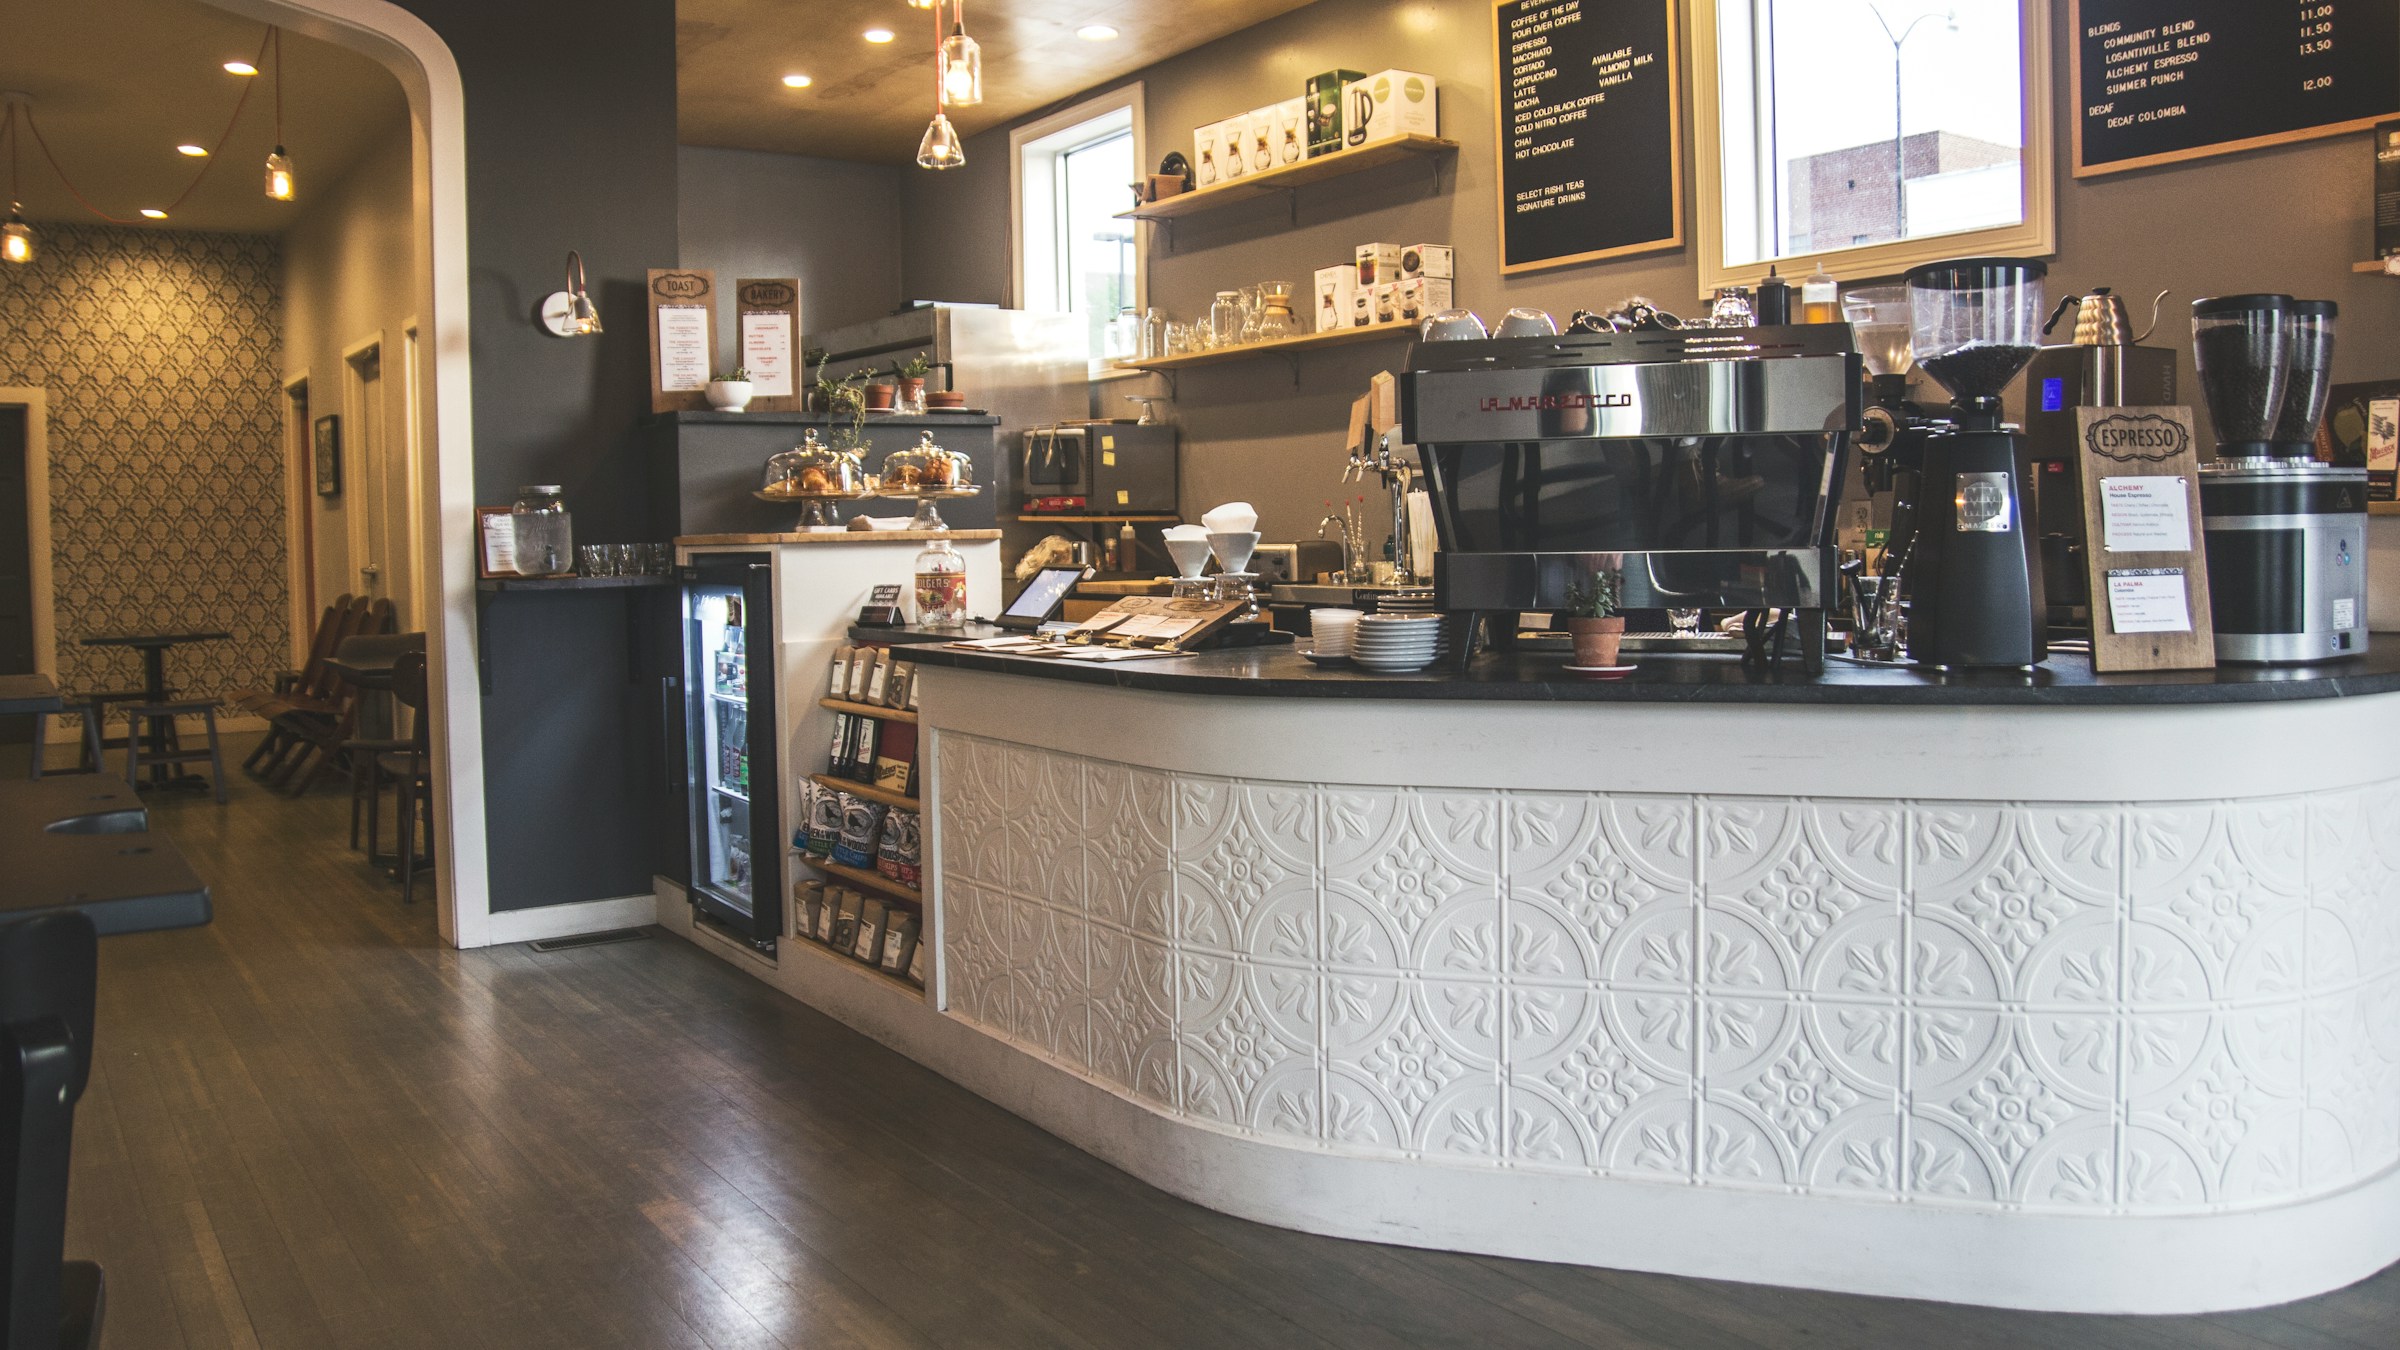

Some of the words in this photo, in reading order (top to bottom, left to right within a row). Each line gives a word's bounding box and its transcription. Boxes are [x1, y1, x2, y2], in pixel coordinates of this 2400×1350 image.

[1520, 0, 1556, 10] BEVER
[2301, 5, 2333, 21] 11.00
[1511, 14, 1538, 28] COFFEE
[1539, 10, 1549, 20] OF
[1551, 5, 1564, 16] THE
[1565, 0, 1580, 11] DAY
[1512, 27, 1532, 40] POUR
[1533, 20, 1553, 33] OVER
[1554, 12, 1581, 27] COFFEE
[2088, 22, 2121, 37] BLENDS
[2104, 28, 2156, 49] COMMUNITY
[2162, 19, 2195, 36] BLEND
[2300, 22, 2332, 38] 11.50
[1512, 36, 1547, 53] ESPRESSO
[2106, 41, 2170, 64] LOSANTIVILLE
[2177, 32, 2211, 48] BLEND
[2300, 39, 2332, 55] 13.50
[1512, 46, 1552, 64] MACCHIATO
[1592, 46, 1632, 65] AVAILABLE
[1513, 60, 1545, 76] CORTADO
[1599, 59, 1630, 75] ALMOND
[1633, 53, 1654, 66] MILK
[2106, 62, 2148, 80] ALCHEMY
[2154, 52, 2199, 69] ESPRESSO
[1513, 68, 1557, 87] CAPPUCCINO
[1599, 71, 1633, 88] VANILLA
[2106, 78, 2147, 95] SUMMER
[2151, 70, 2184, 86] PUNCH
[2303, 76, 2332, 90] 12.00
[1513, 86, 1536, 98] LATTE
[1514, 96, 1540, 109] MOCHA
[1515, 112, 1532, 123] ICED
[1534, 106, 1553, 118] COLD
[1554, 100, 1576, 112] BLACK
[1577, 92, 1605, 107] COFFEE
[2089, 102, 2114, 116] DECAF
[1515, 122, 1533, 134] COLD
[1535, 117, 1557, 129] NITRO
[1559, 109, 1588, 123] COFFEE
[2107, 114, 2135, 128] DECAF
[2138, 105, 2186, 123] COLOMBIA
[1515, 137, 1532, 148] CHAI
[1515, 149, 1531, 159] HOT
[1532, 138, 1575, 155] CHOCOLATE
[1517, 189, 1542, 201] SELECT
[1544, 184, 1564, 195] RISHI
[1566, 180, 1585, 191] TEAS
[1517, 198, 1555, 213] SIGNATURE
[1558, 191, 1586, 204] DRINKS
[667, 281, 695, 291] TOAST
[751, 290, 784, 300] BAKERY
[1480, 397, 1497, 411] LA
[2102, 429, 2173, 447] ESPRESSO
[917, 578, 950, 589] OLGERS
